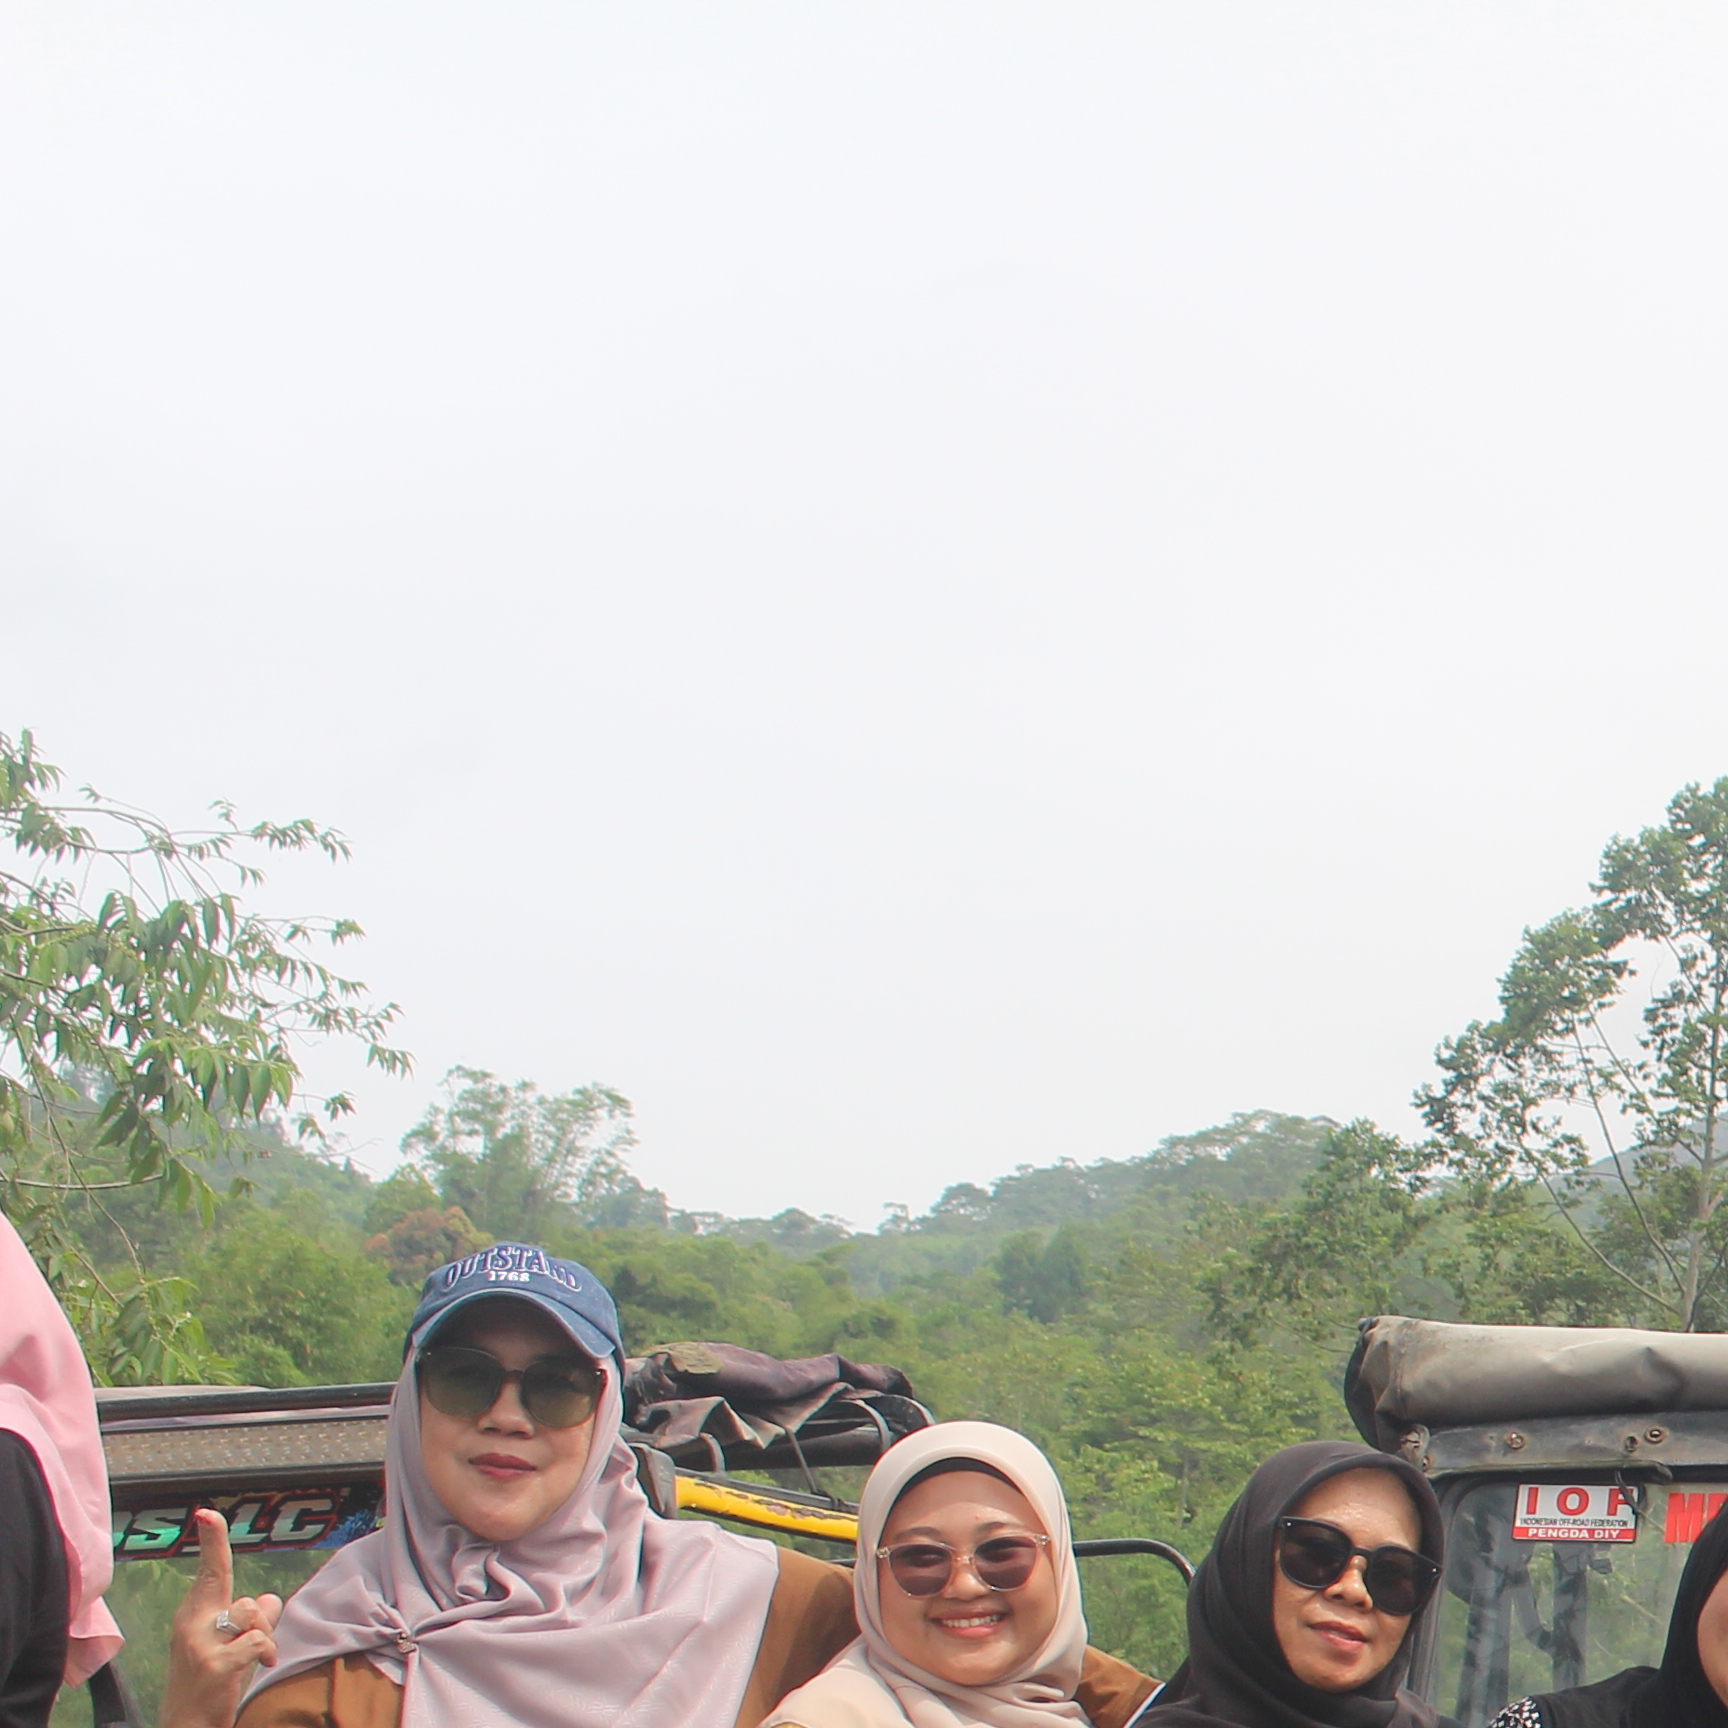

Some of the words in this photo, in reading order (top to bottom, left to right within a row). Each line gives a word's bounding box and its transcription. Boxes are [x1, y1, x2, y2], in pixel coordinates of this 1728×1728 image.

[488, 1270, 530, 1283] 1768
[1528, 1528, 1589, 1539] PENGDA
[1594, 1529, 1620, 1539] DIY
